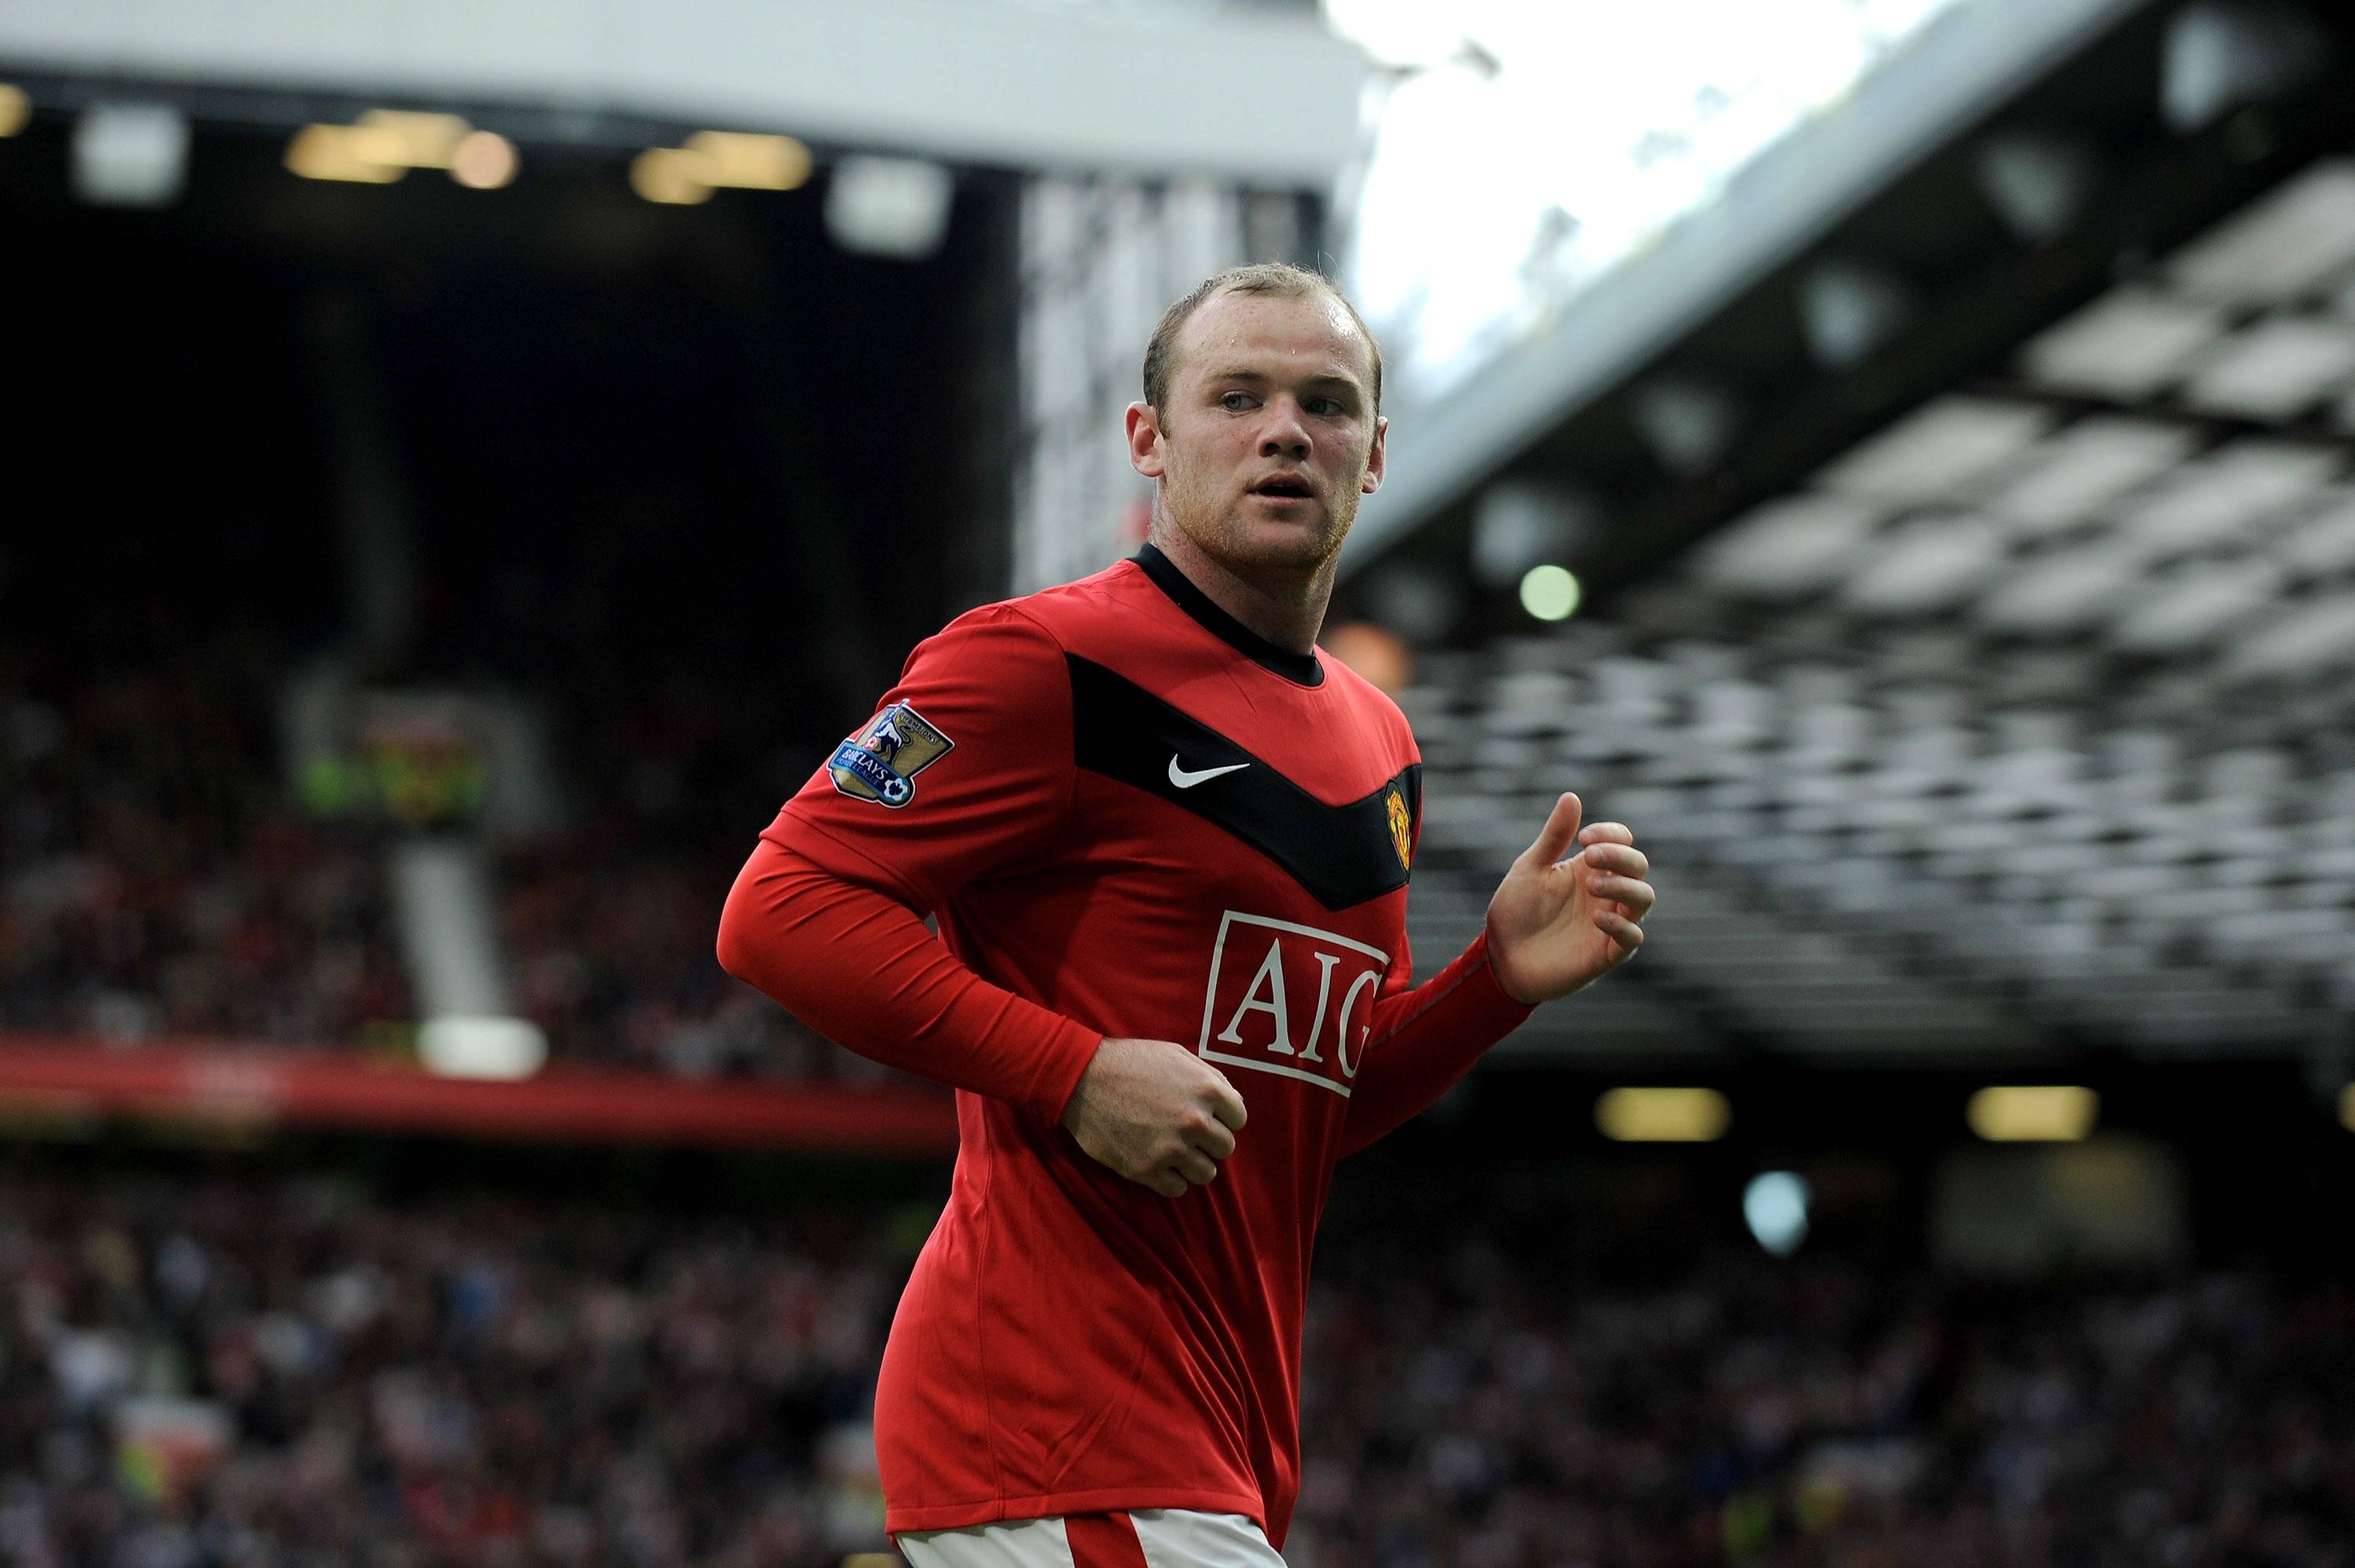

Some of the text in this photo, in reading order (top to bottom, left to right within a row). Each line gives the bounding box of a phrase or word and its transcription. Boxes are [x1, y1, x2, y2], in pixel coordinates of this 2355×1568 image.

[899, 713, 937, 744] CHAMPIONS
[842, 749, 888, 779] BARCLAYS
[1218, 938, 1382, 1078] AIG
